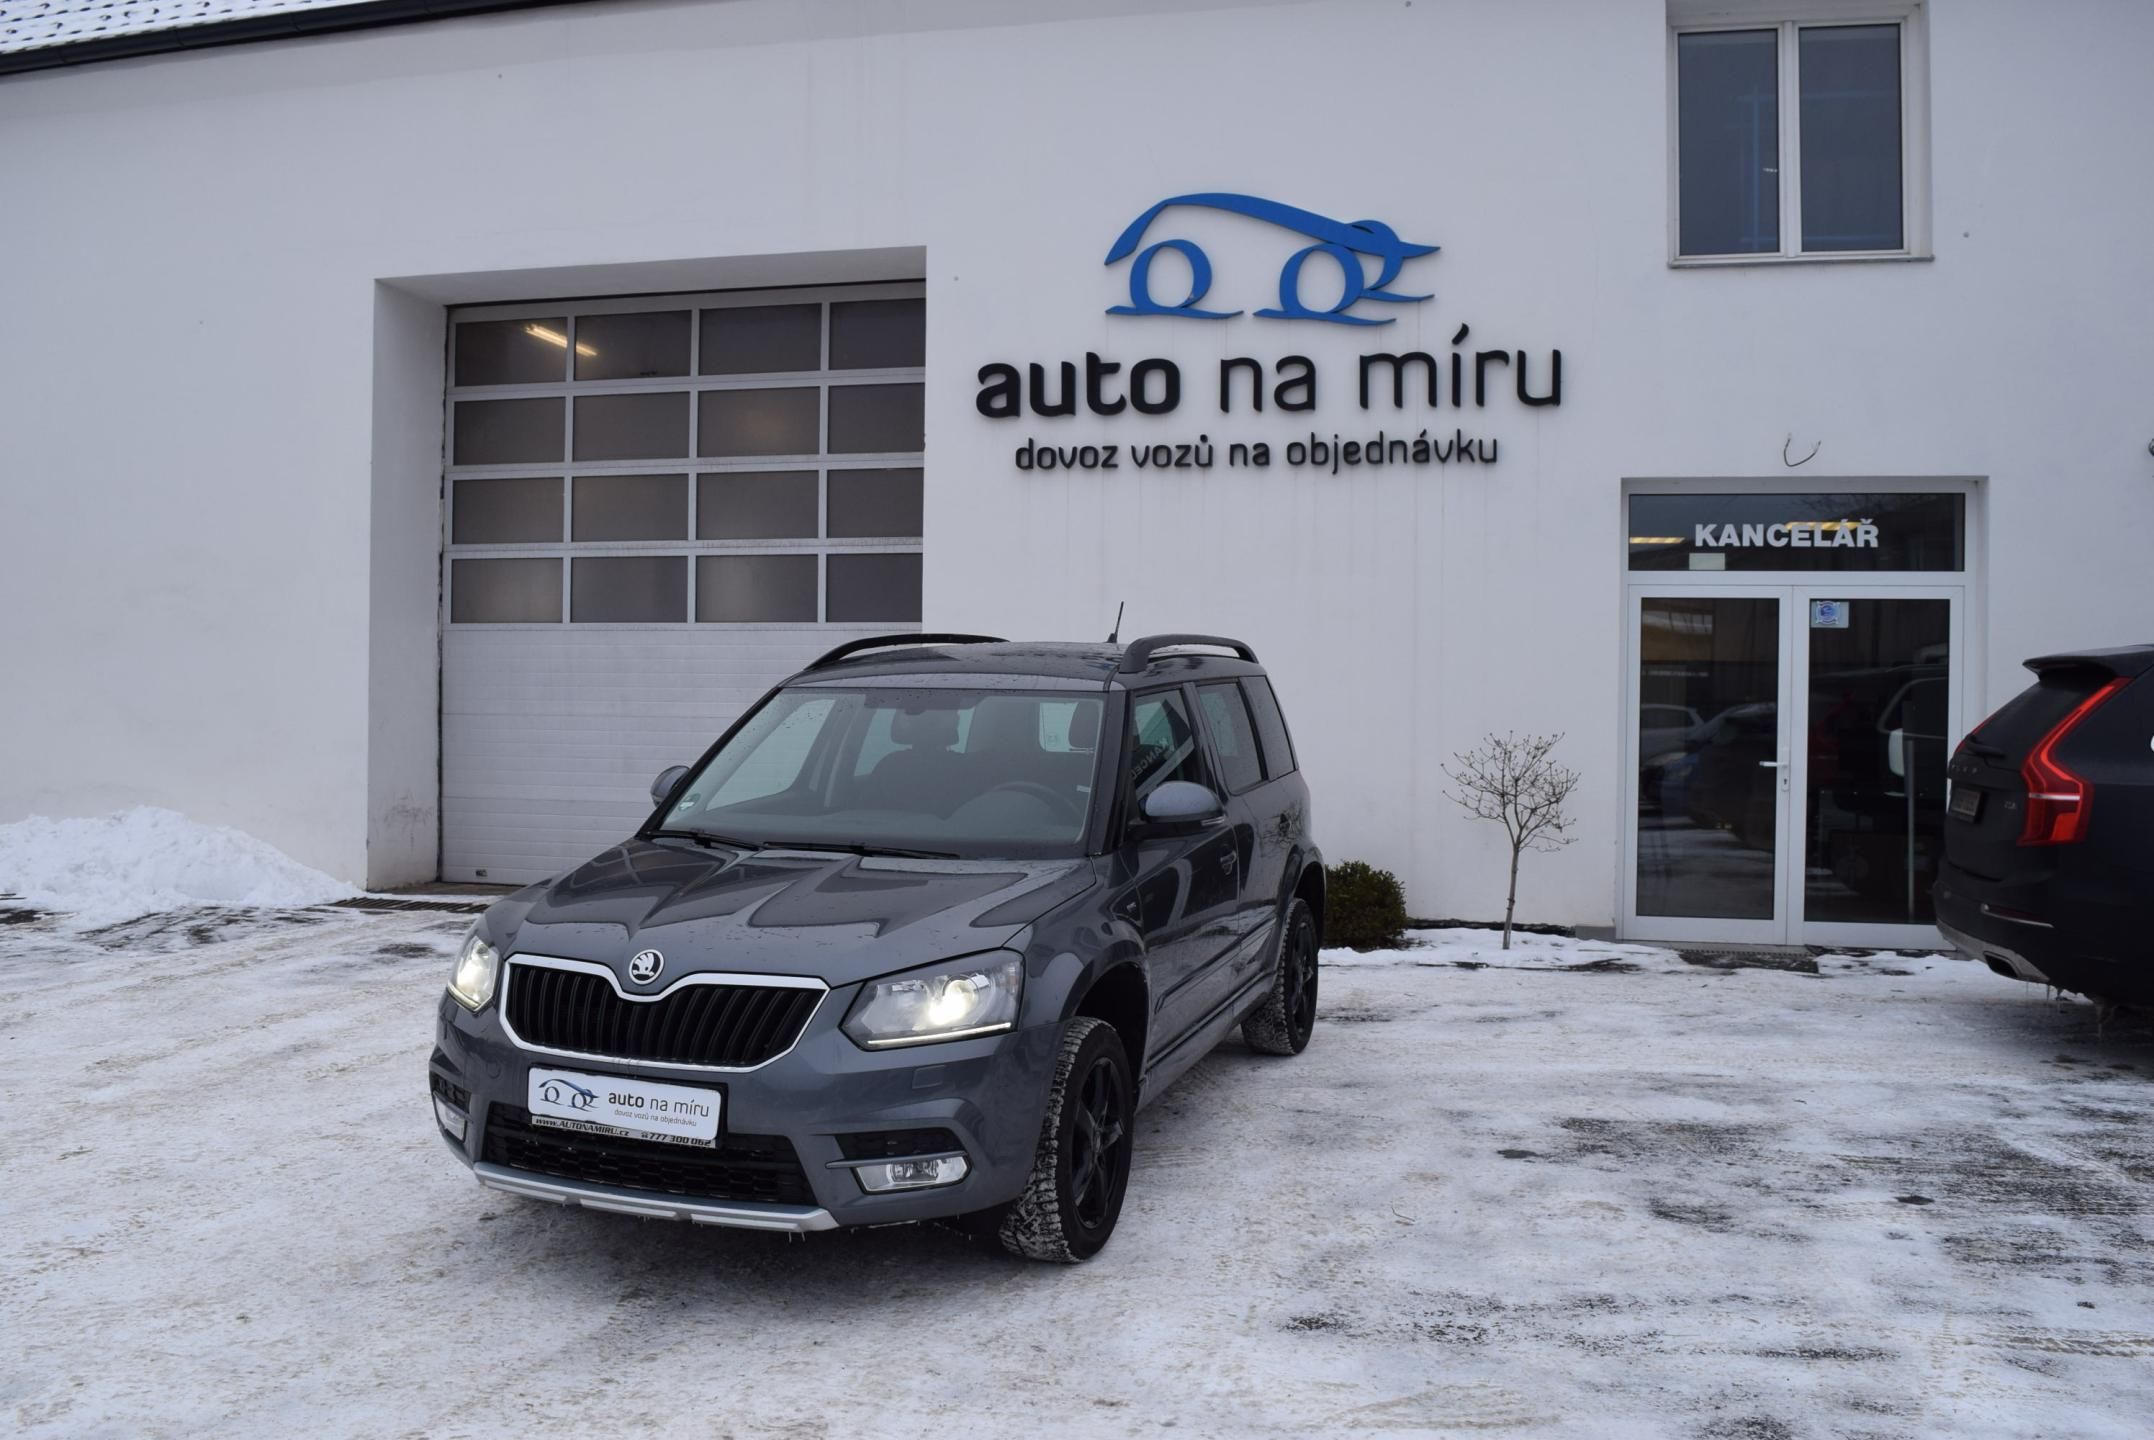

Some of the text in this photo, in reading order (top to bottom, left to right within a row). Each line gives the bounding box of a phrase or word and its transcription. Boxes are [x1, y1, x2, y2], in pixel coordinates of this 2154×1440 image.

[976, 323, 1562, 419] auto na míru
[1015, 429, 1498, 475] dovoz vozů na objednávku
[1695, 518, 1879, 548] KANCELÁŘ
[608, 1092, 709, 1118] auto na míru
[614, 1109, 632, 1118] dovoz
[660, 1115, 697, 1127] objednávku
[650, 1132, 668, 1141] 777
